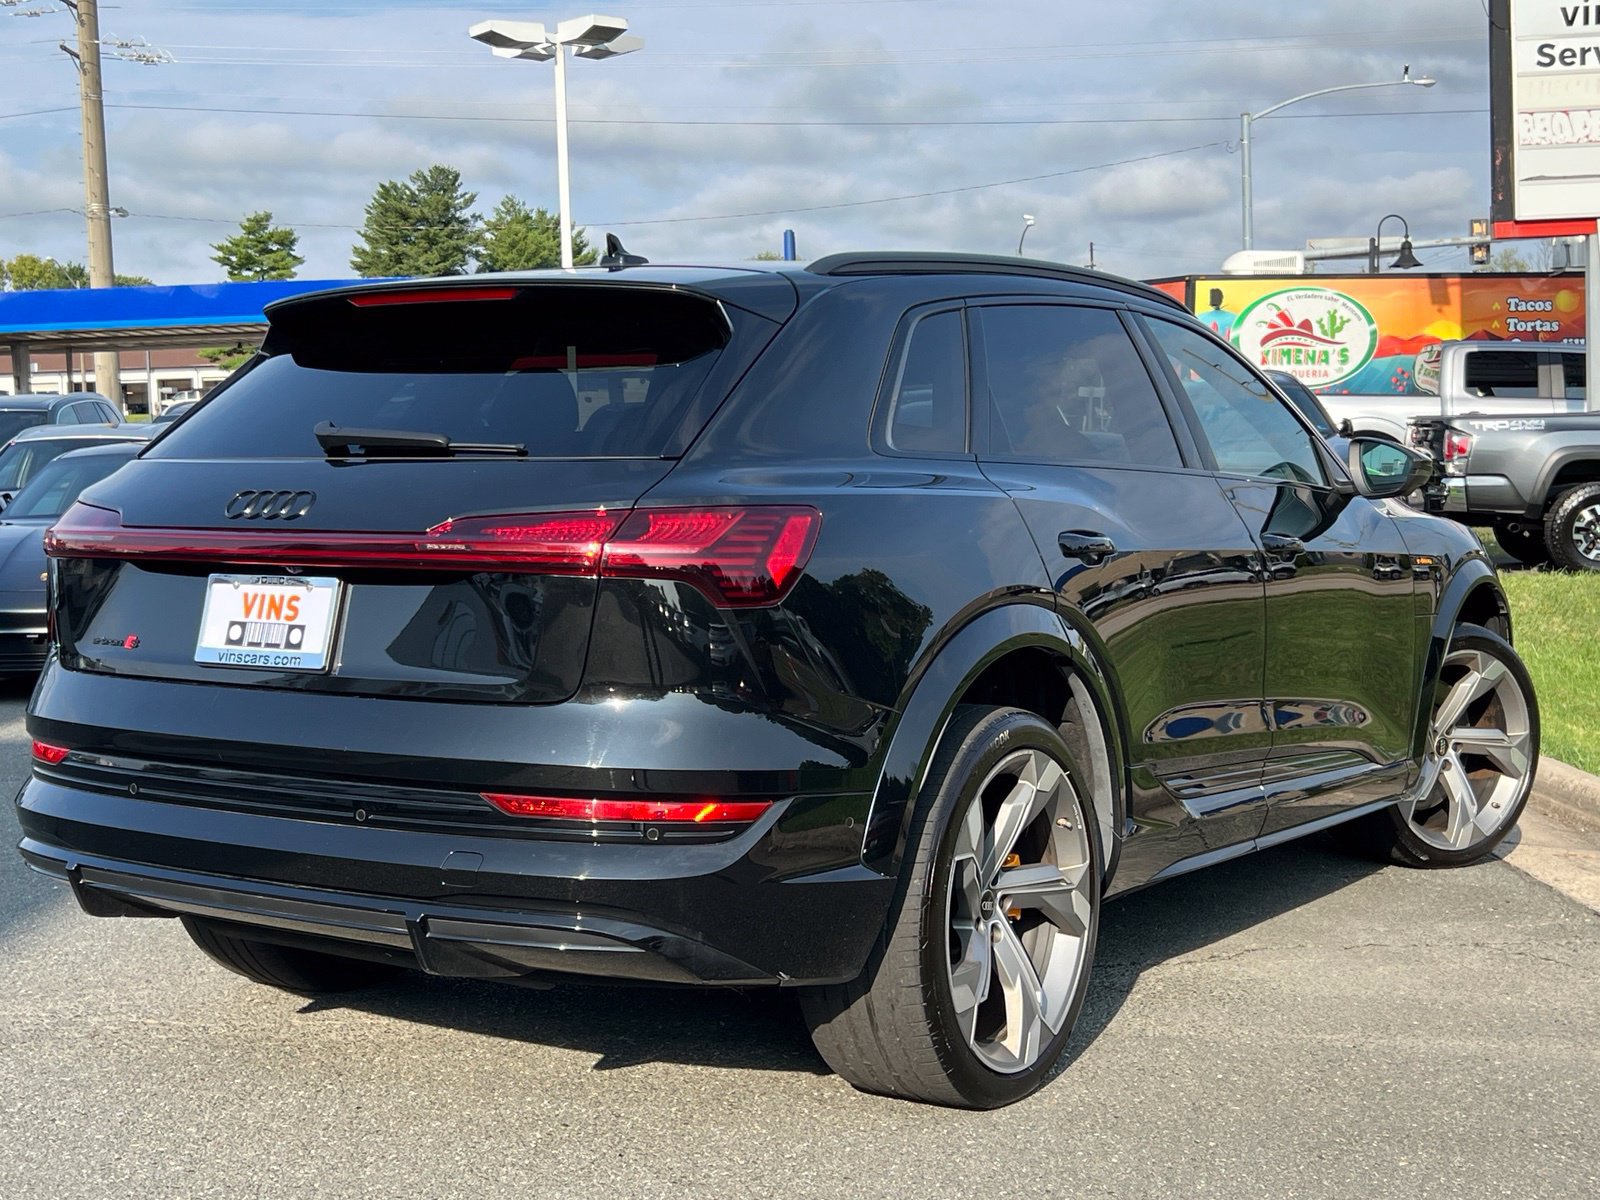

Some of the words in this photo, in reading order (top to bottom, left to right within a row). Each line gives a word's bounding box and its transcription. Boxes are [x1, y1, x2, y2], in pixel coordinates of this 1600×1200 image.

[1507, 297, 1553, 312] Tacos
[1506, 317, 1559, 332] Tortas
[1260, 346, 1350, 366] XIMENA'S
[1469, 420, 1509, 431] TRD
[242, 592, 301, 622] VINS
[218, 650, 301, 666] vinscars.com
